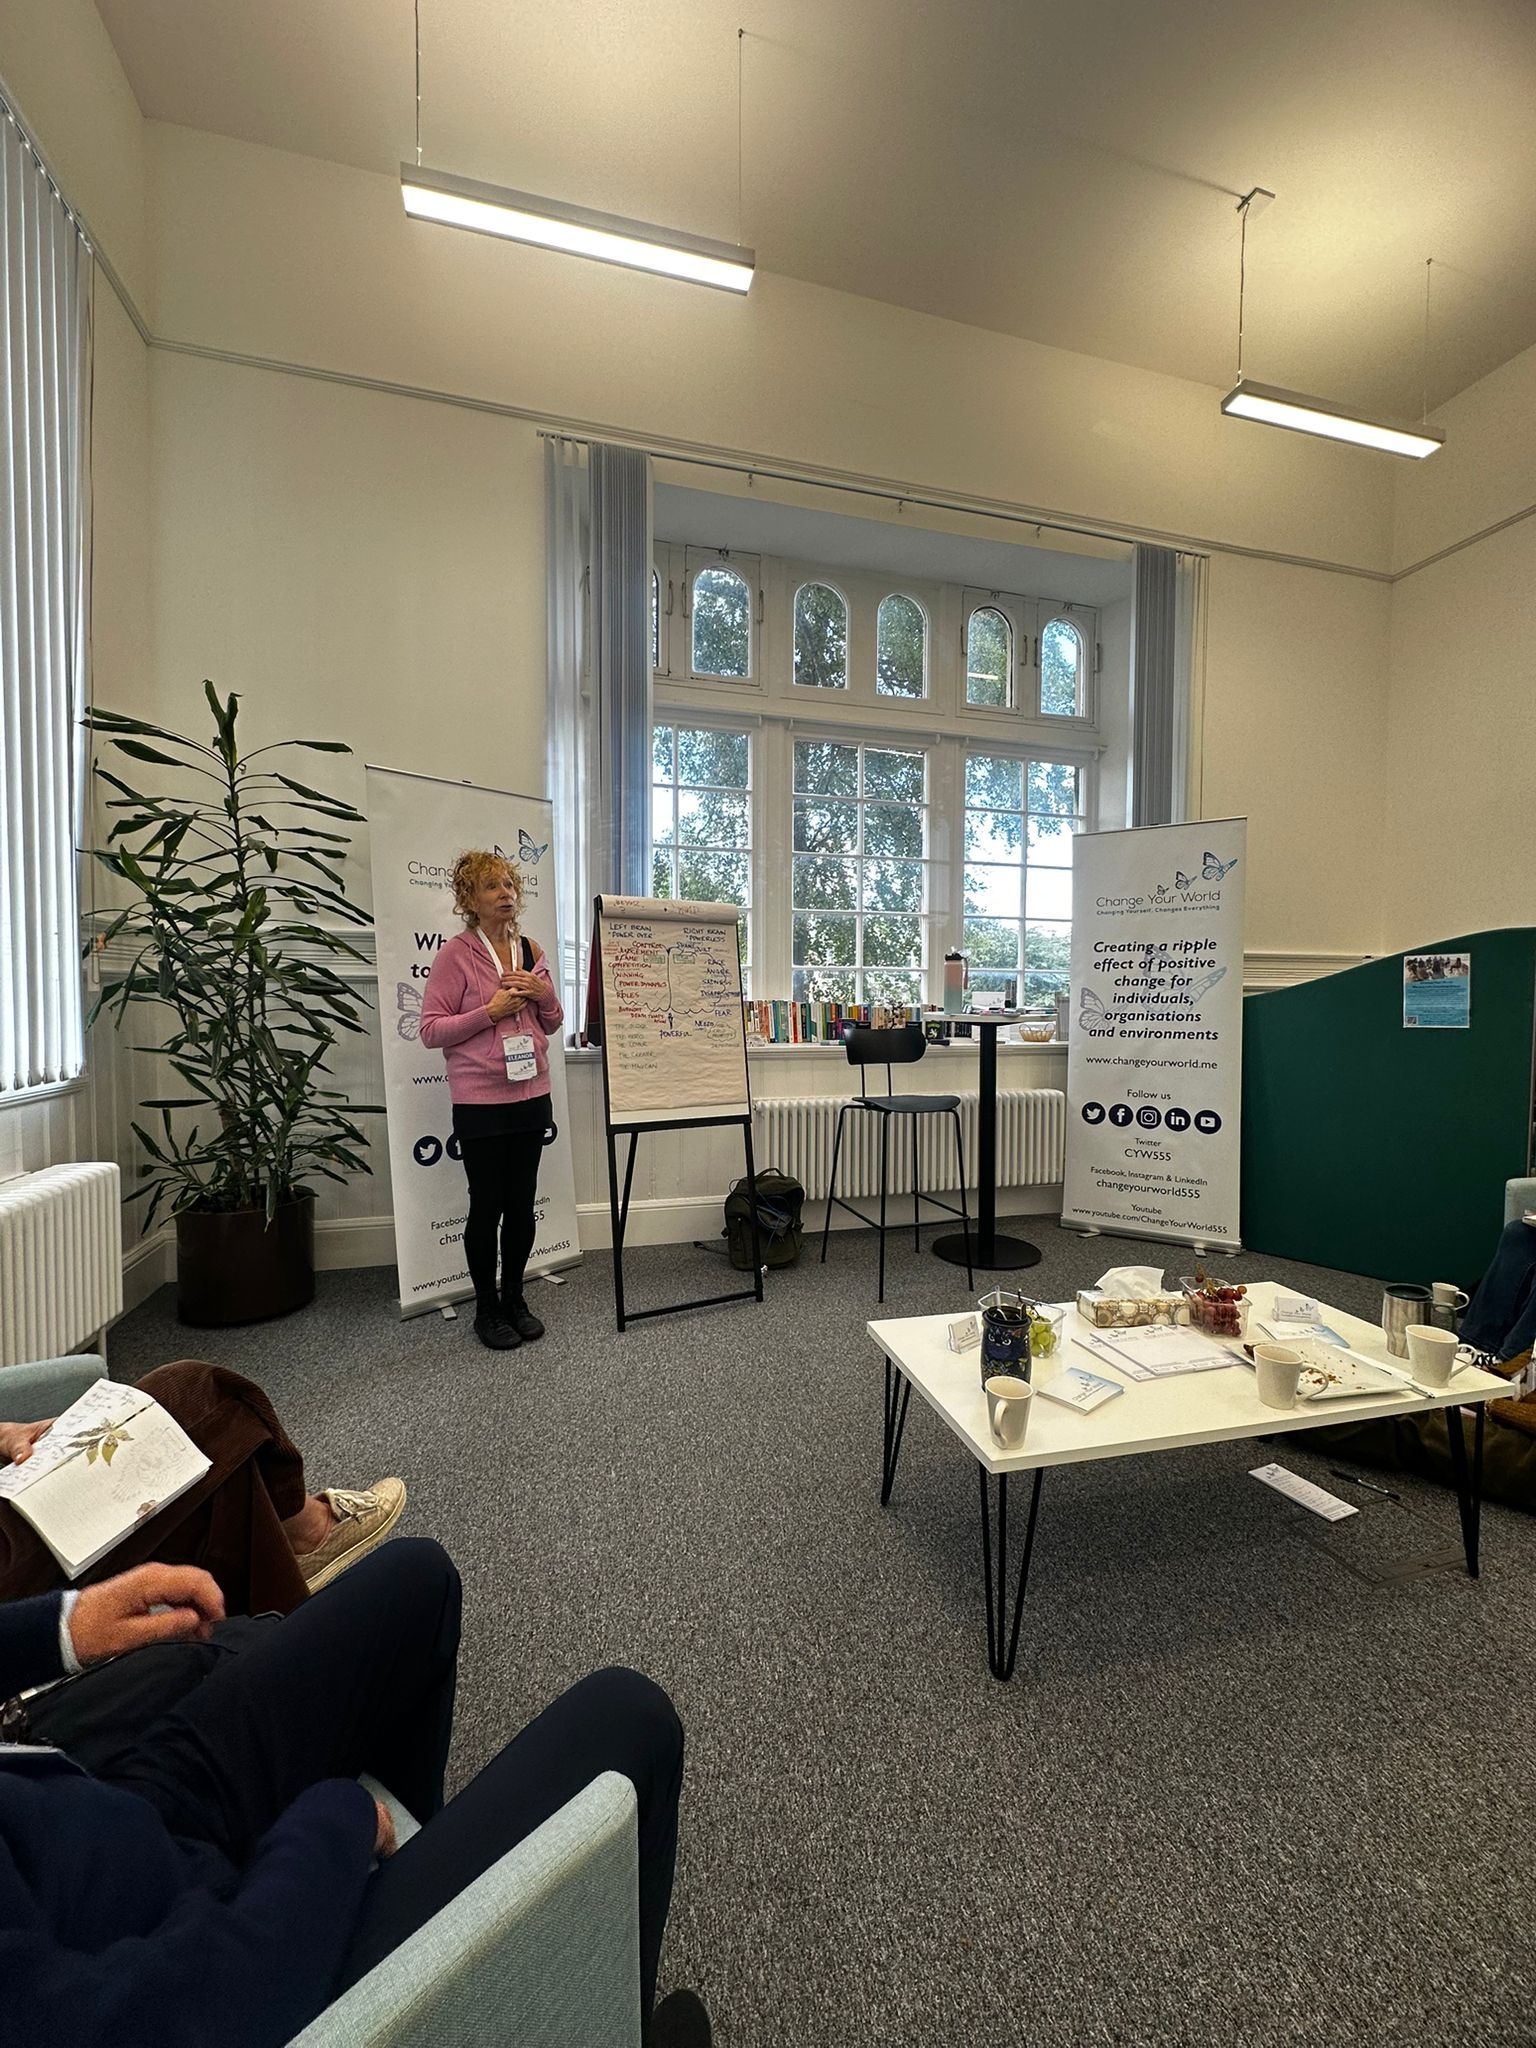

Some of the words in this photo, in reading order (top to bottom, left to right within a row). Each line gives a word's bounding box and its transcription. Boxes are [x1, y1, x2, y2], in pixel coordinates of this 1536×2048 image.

[408, 861, 454, 883] Chang
[522, 874, 538, 886] rld
[1096, 897, 1144, 909] Change
[1147, 894, 1177, 904] Your
[1181, 890, 1221, 902] World
[1184, 904, 1220, 912] Everything
[414, 932, 448, 951] Wh
[1094, 941, 1154, 955] Creating
[1159, 943, 1168, 951] a
[1173, 938, 1217, 954] ripple
[1094, 958, 1134, 972] effect
[1139, 957, 1155, 972] of
[1158, 957, 1216, 973] positive
[1114, 975, 1166, 988] change
[1170, 974, 1193, 989] for
[1113, 991, 1194, 1006] individuals,
[1104, 1010, 1202, 1023] organisations
[1089, 1027, 1115, 1038] and
[1119, 1028, 1219, 1040] environments
[508, 1053, 533, 1061] ELEANOR
[1086, 1056, 1218, 1070] www.changeyourworld.me
[1127, 1089, 1158, 1099] Follow
[1135, 1138, 1162, 1147] Twitter
[1090, 1166, 1127, 1178] Facebook,
[1128, 1170, 1164, 1181] Instagram
[1174, 1175, 1208, 1186] LinkedIn
[1131, 1204, 1162, 1215] Youtube
